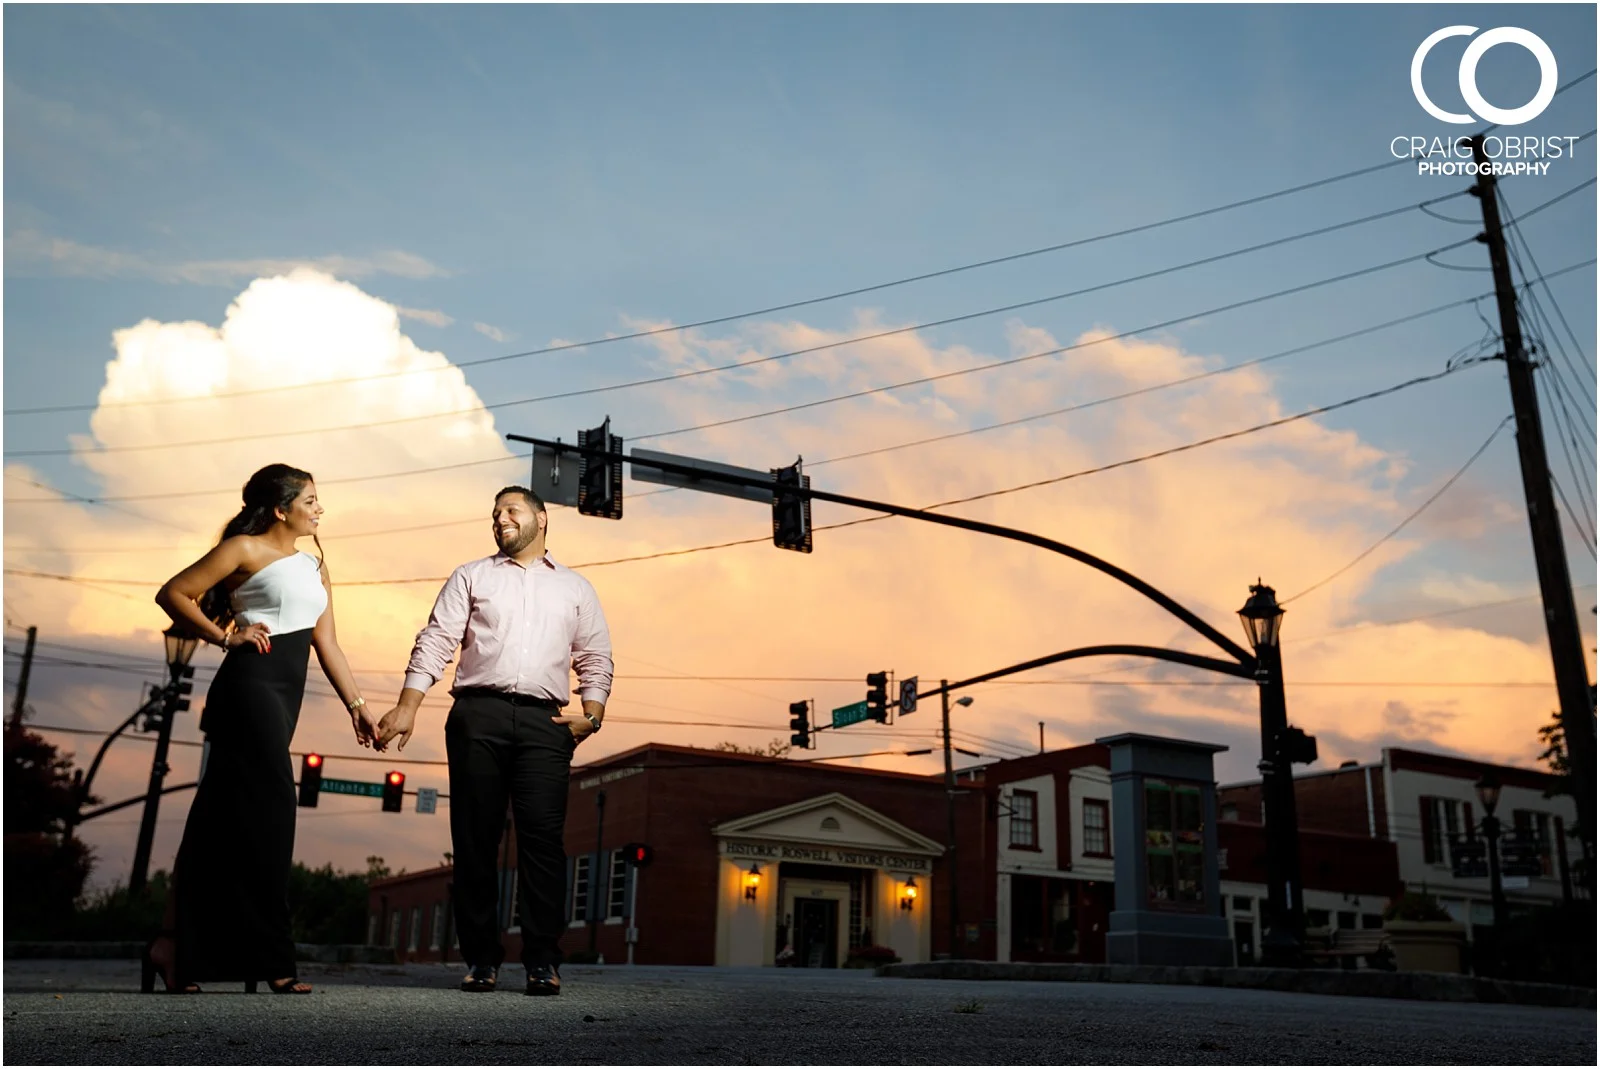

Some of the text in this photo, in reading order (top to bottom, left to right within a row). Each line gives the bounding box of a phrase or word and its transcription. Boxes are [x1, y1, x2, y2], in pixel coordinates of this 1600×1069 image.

[321, 780, 366, 794] Atlanta
[726, 842, 928, 870] HISTORIC ROSWELL VISITORS CENTER
